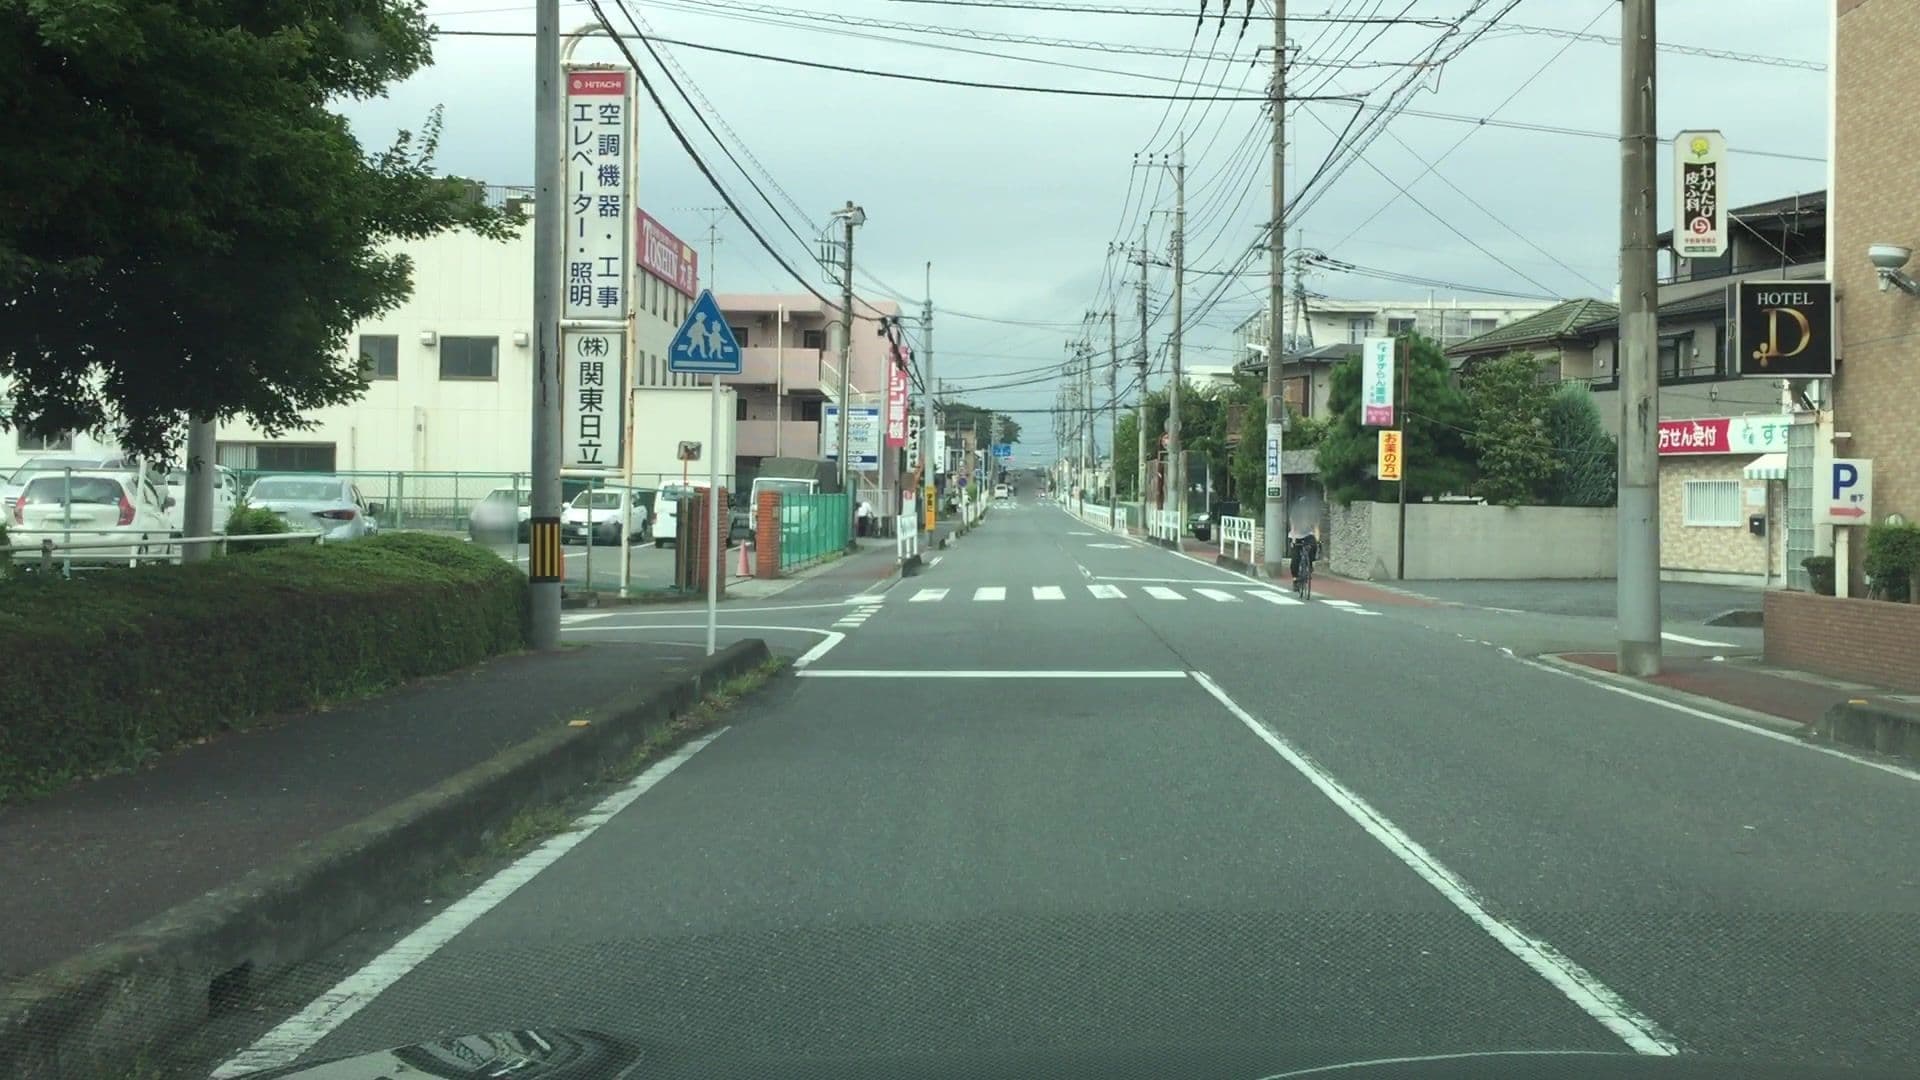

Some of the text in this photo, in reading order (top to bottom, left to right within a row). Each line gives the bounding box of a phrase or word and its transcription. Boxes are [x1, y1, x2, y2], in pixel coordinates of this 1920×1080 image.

[585, 80, 622, 89] HITACHI
[597, 103, 621, 309] 空調機器・工事
[1686, 171, 1700, 212] 皮ふ科
[643, 218, 679, 283] TOSHIN
[1757, 291, 1814, 305] HOTEL
[1762, 307, 1810, 357] D
[1384, 433, 1397, 473] お薬の方
[1832, 463, 1858, 500] P
